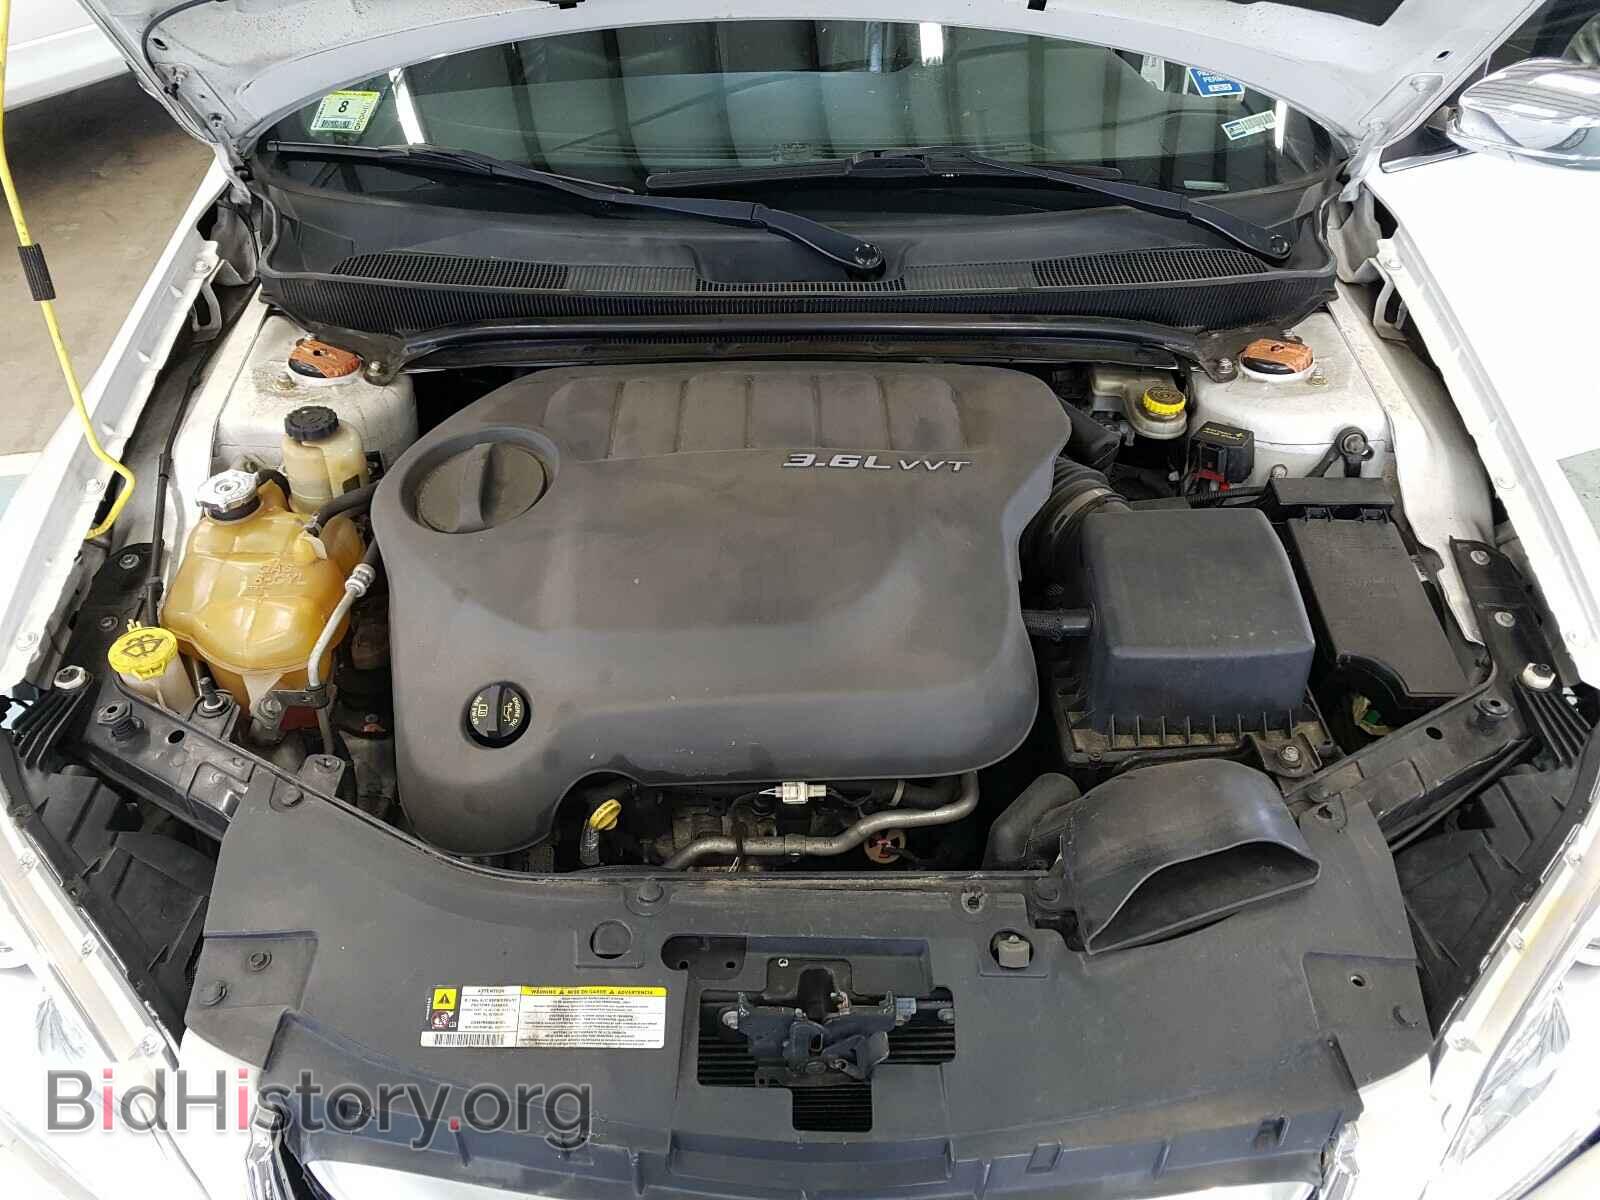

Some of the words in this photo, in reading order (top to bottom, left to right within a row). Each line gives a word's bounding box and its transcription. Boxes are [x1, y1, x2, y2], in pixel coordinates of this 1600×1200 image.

[338, 100, 349, 113] 8
[783, 453, 892, 470] 3.6L
[899, 459, 972, 472] VVT
[512, 697, 521, 717] ENGINE
[509, 718, 519, 727] OIL
